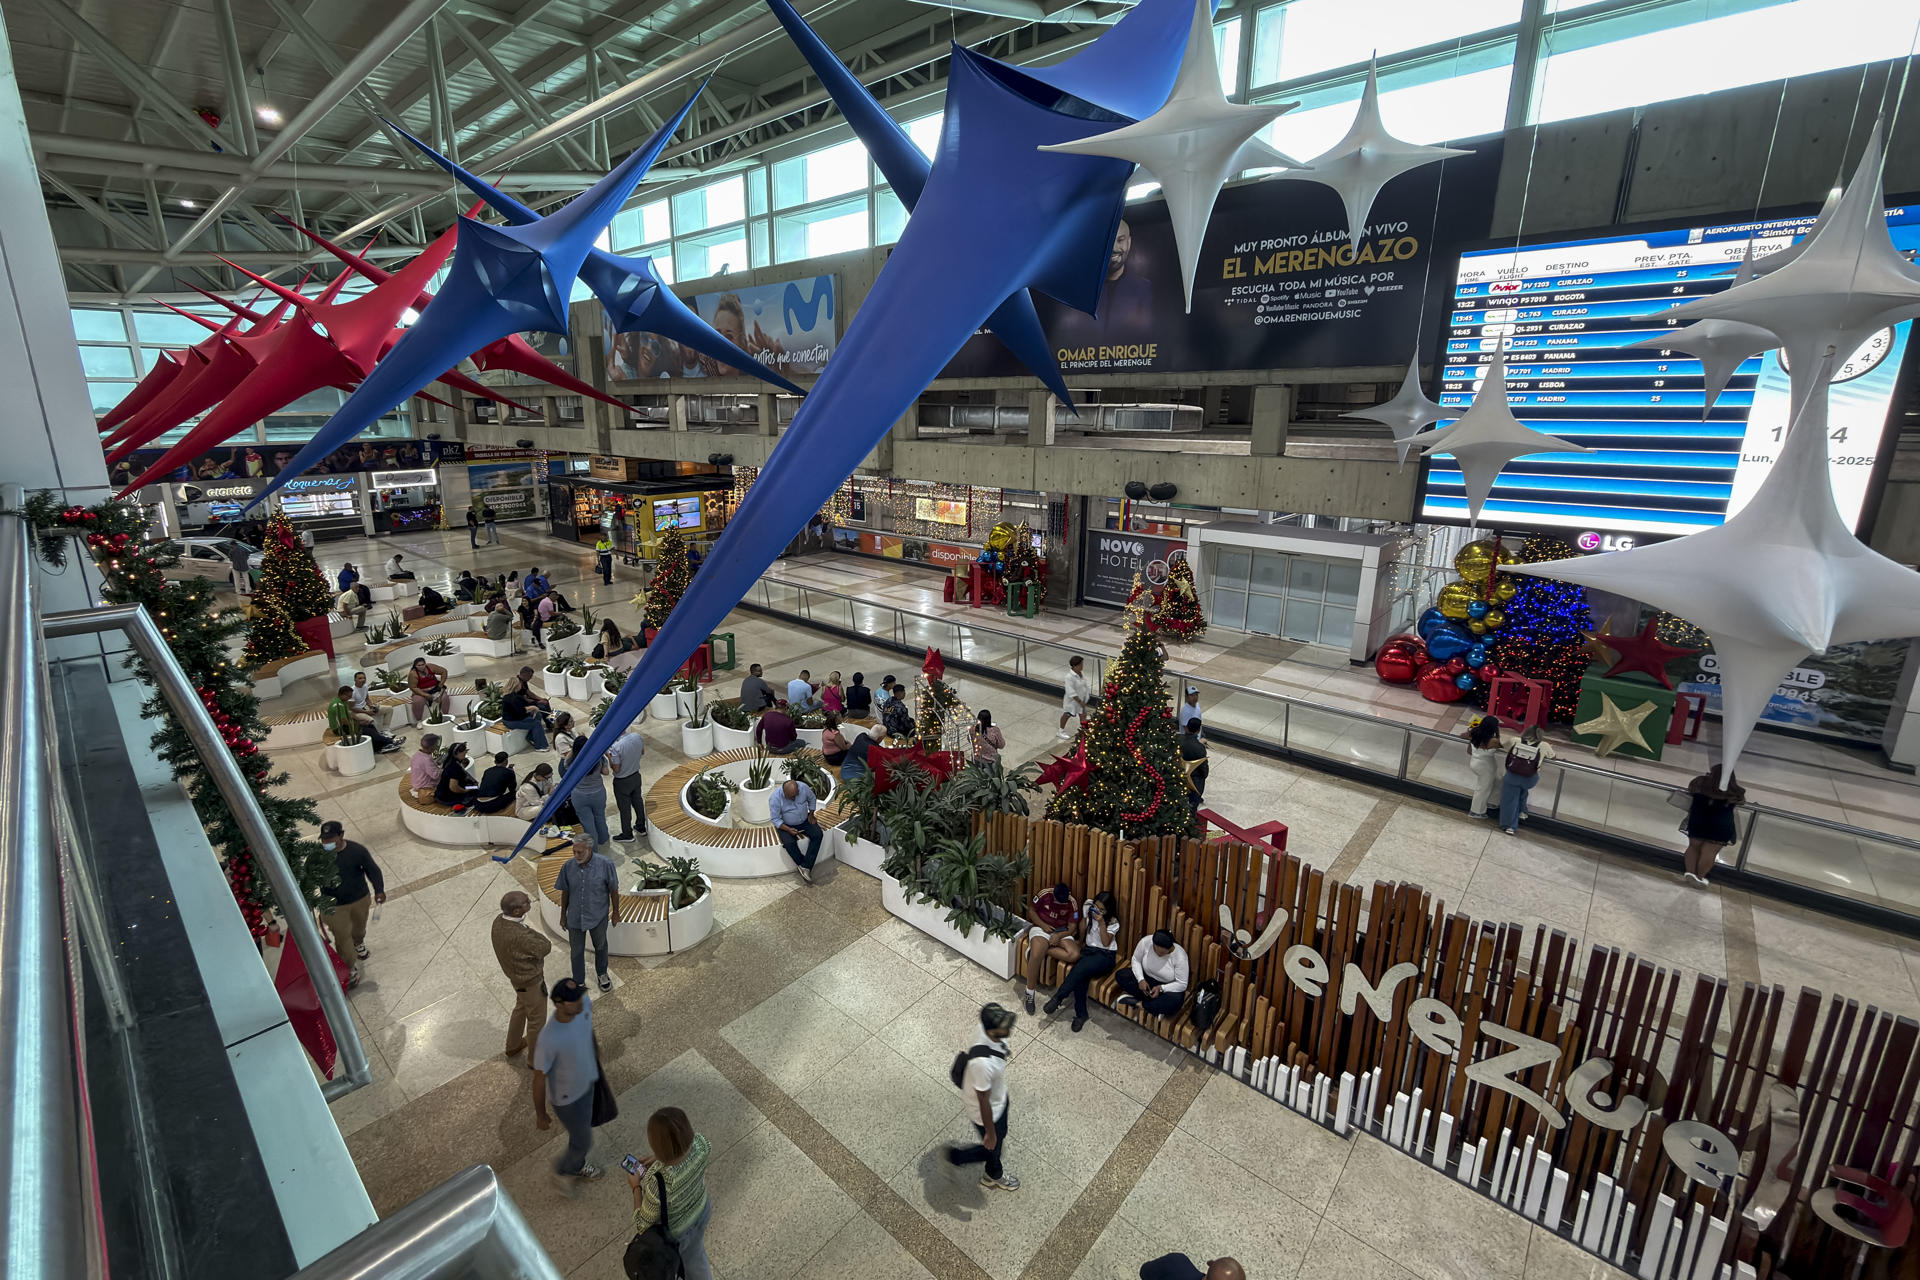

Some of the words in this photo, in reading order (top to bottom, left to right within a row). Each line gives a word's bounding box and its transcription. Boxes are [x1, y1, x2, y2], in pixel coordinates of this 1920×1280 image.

[1705, 223, 1763, 235] AEROPUERTO
[1234, 240, 1258, 254] MUY
[1260, 233, 1308, 249] PRONTO
[1311, 229, 1350, 244] ÁLBUM
[1375, 221, 1408, 234] VIVO
[1222, 256, 1247, 279] EL
[1254, 236, 1418, 276] MERENGAZO
[1460, 270, 1486, 278] HORA
[1497, 266, 1528, 275] VUELO
[1545, 261, 1589, 271] DESTINO
[1634, 253, 1666, 263] PREV.
[1669, 252, 1693, 261] PTA.
[1231, 283, 1275, 296] ESCUCHA
[1279, 280, 1307, 291] TODA
[1309, 279, 1322, 289] MI
[1325, 274, 1366, 287] MÚSICA
[1370, 271, 1395, 283] POR
[1460, 286, 1478, 294] 12:45
[1491, 282, 1521, 292] Avior
[1557, 277, 1594, 287] CURAZAO
[1270, 294, 1290, 302] Spotify
[1300, 291, 1322, 299] Music
[1337, 288, 1359, 296] YouTube
[1377, 284, 1404, 292] DEEZER
[1302, 301, 1333, 309] PANDORA
[1457, 300, 1476, 308] 13:22
[1488, 296, 1518, 306] wingo
[1554, 293, 1586, 302] BOGOTA
[1254, 308, 1362, 325] @OMARENRIQUEMUSIC
[1456, 315, 1474, 323] 13:45
[1551, 307, 1588, 316] CURAZAO
[1453, 328, 1472, 336] 14:45
[1548, 322, 1585, 331] CURAZAO
[1546, 337, 1579, 346] PANAMA
[1872, 338, 1882, 348] 3
[777, 350, 791, 371] que
[792, 343, 829, 364] conectan
[1057, 346, 1096, 362] OMAR
[1099, 343, 1158, 361] ENRIQUE
[1543, 352, 1576, 360] PANAMA
[1861, 353, 1871, 363] 4
[1060, 361, 1067, 369] EL
[1100, 360, 1113, 368] DEL
[1114, 358, 1152, 367] MERENGUE
[1541, 366, 1572, 374] MADRID
[1843, 363, 1854, 374] 5
[1539, 381, 1566, 389] LISBOA
[1536, 395, 1566, 403] MADRID
[207, 486, 253, 497] GIORGIO
[1603, 535, 1634, 551] LG
[1100, 553, 1143, 571] HOTEL
